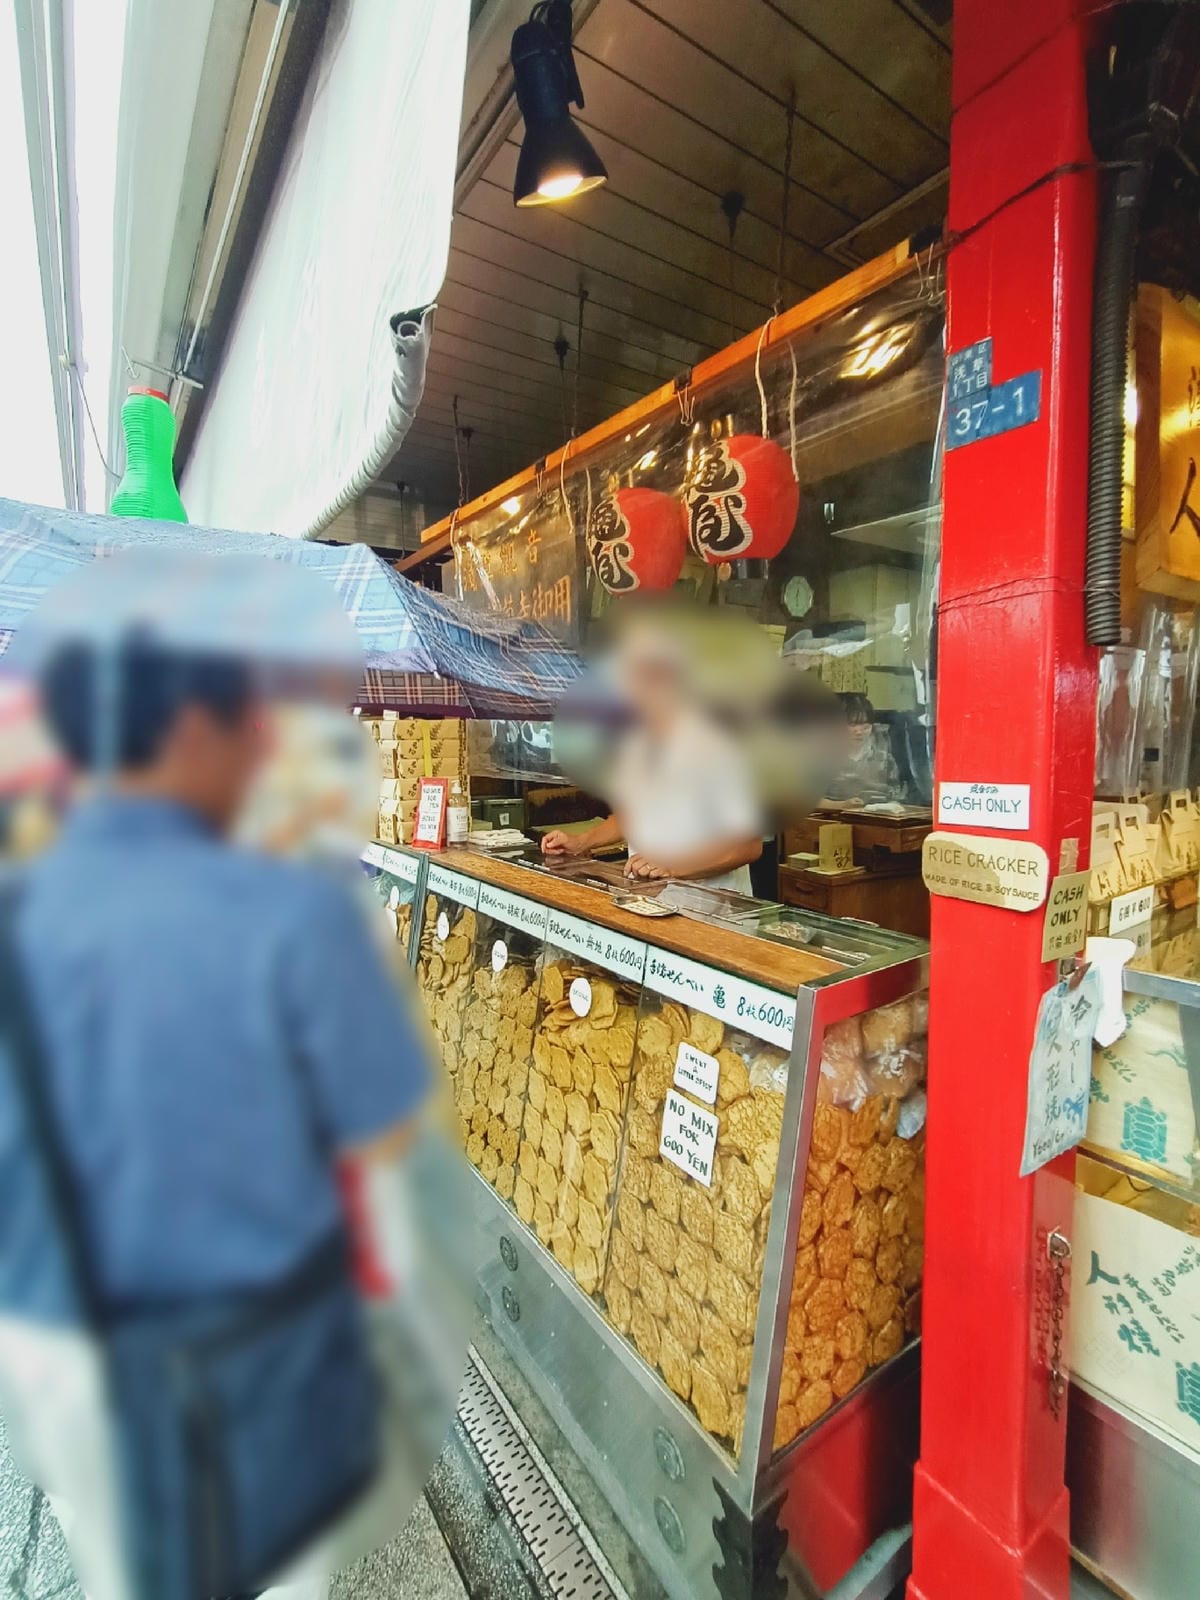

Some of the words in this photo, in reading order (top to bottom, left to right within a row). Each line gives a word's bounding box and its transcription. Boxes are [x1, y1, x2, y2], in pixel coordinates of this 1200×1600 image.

[954, 357, 983, 379] 浅草
[953, 371, 988, 397] 1丁目
[955, 386, 1024, 435] 37-1
[941, 795, 982, 811] CASH
[985, 798, 1022, 813] ONLY
[928, 846, 962, 865] RICE
[967, 853, 1039, 877] CRACKER
[925, 873, 947, 885] MADE
[949, 878, 959, 886] OF
[962, 880, 983, 892] RICE
[1053, 884, 1085, 905] CASH
[1050, 905, 1082, 927] ONLY
[669, 1099, 685, 1117] NO
[691, 1111, 714, 1138] MIX
[679, 1124, 700, 1146] FOR
[663, 1135, 684, 1156] 600
[686, 1149, 708, 1177] YEN
